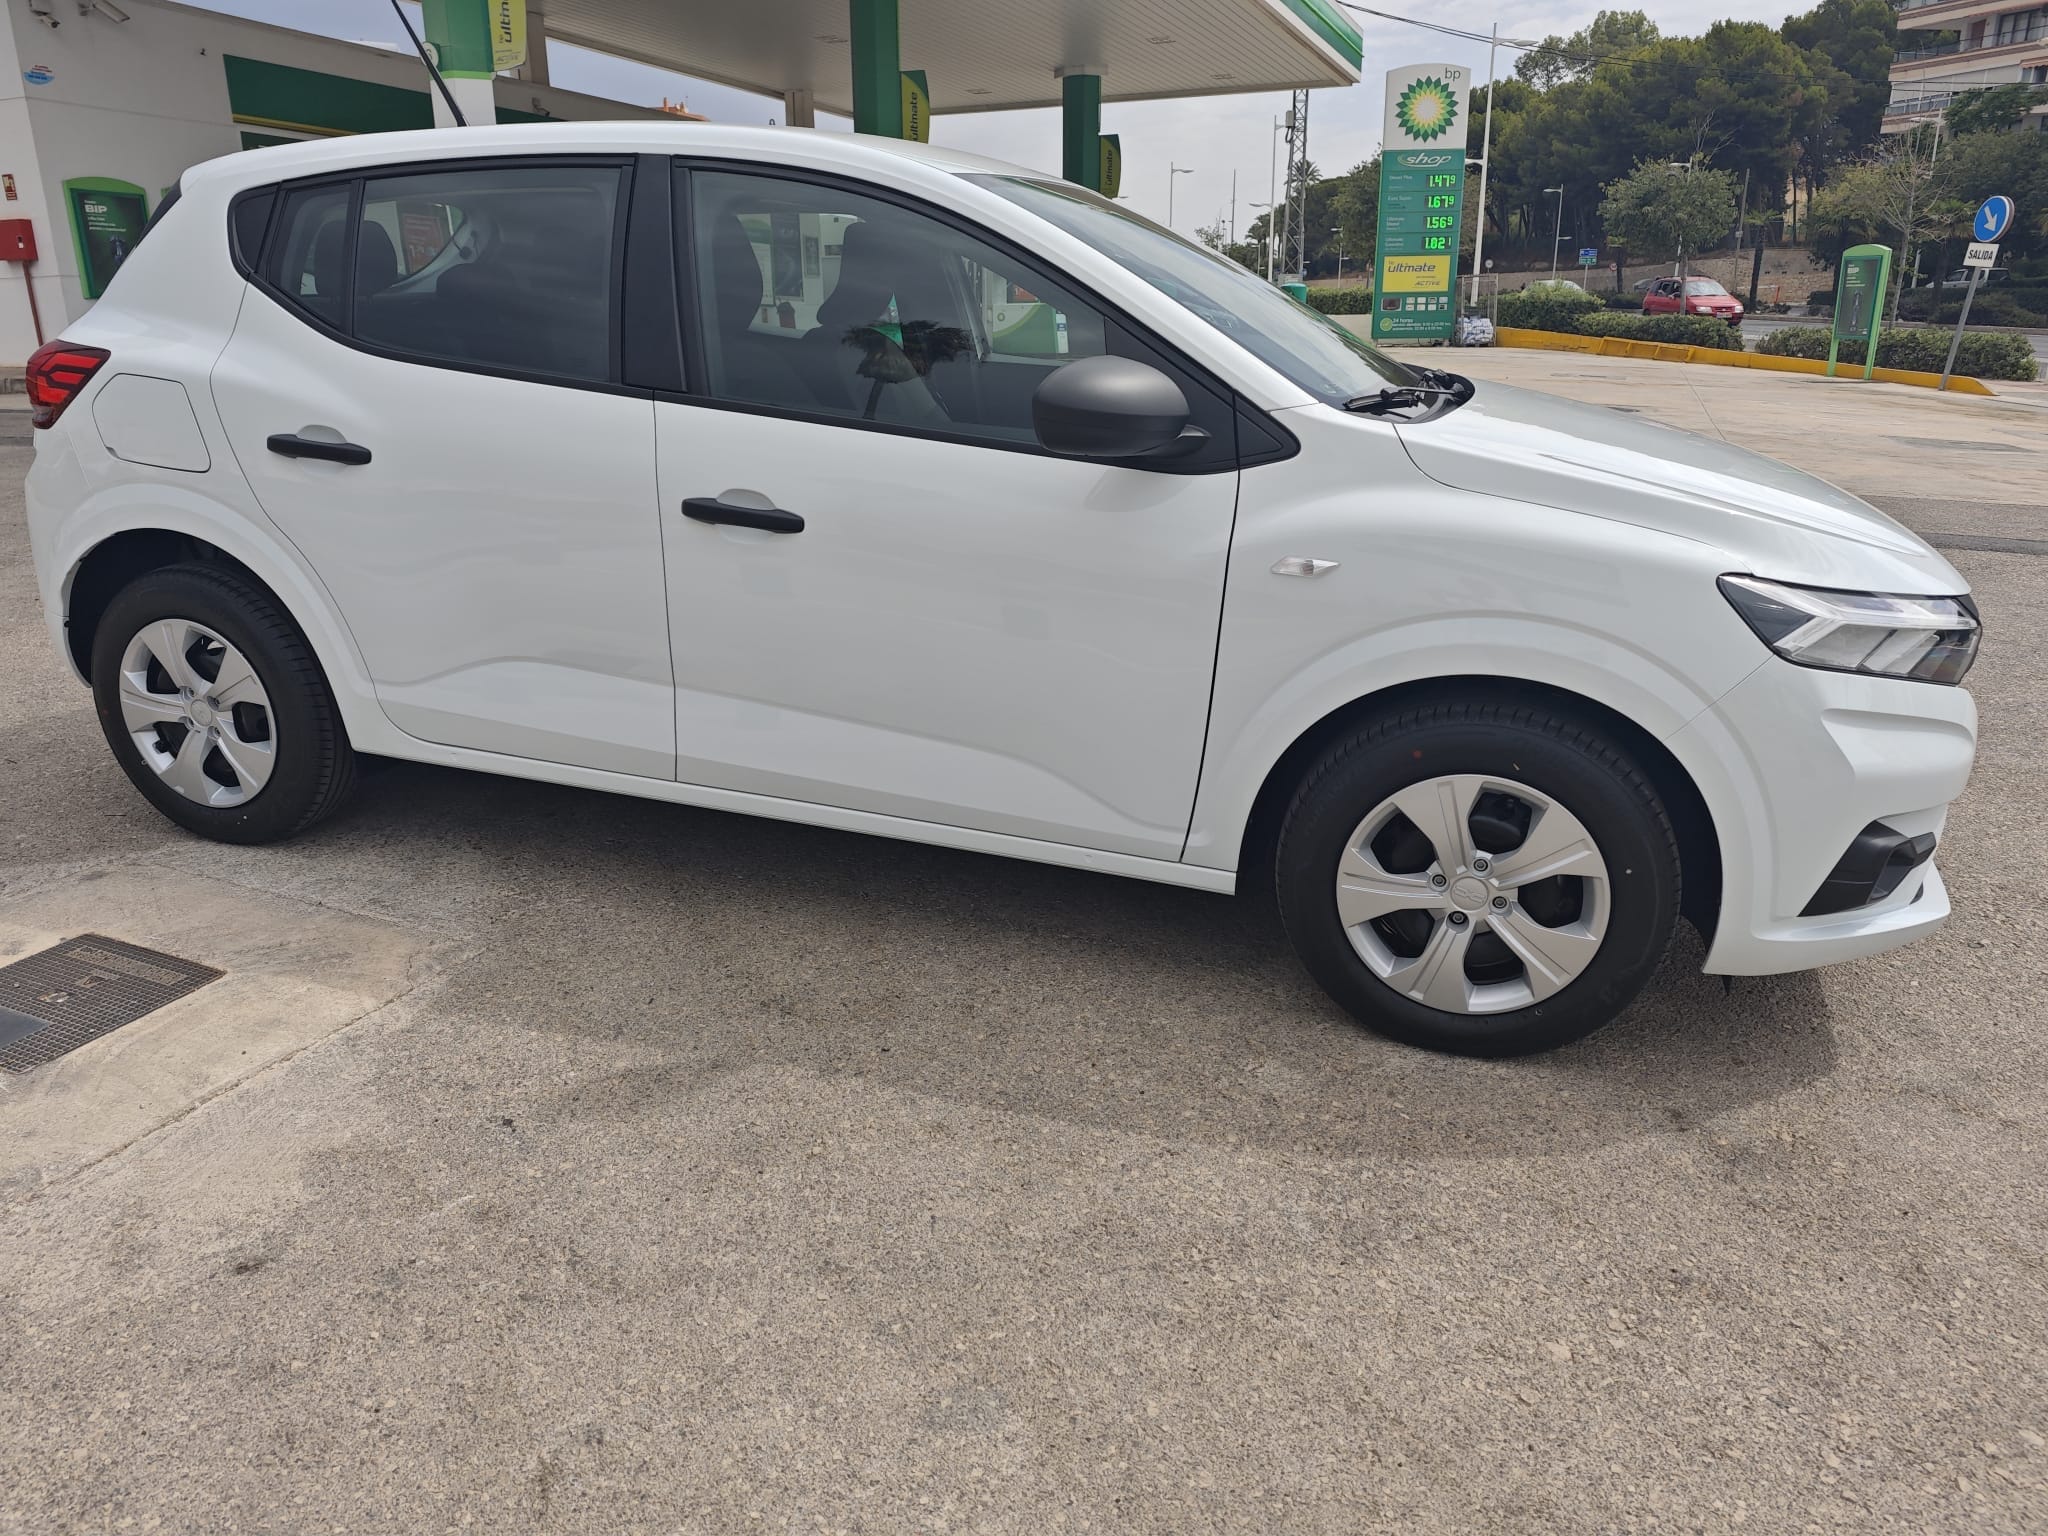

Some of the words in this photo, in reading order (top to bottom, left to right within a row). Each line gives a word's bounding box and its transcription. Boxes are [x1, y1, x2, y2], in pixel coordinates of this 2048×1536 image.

[500, 0, 512, 43] ultim
[1444, 67, 1461, 82] bp
[1405, 153, 1452, 166] shop
[84, 204, 107, 214] BIP
[1968, 249, 1993, 261] SALIDA
[1388, 261, 1436, 273] ultimate
